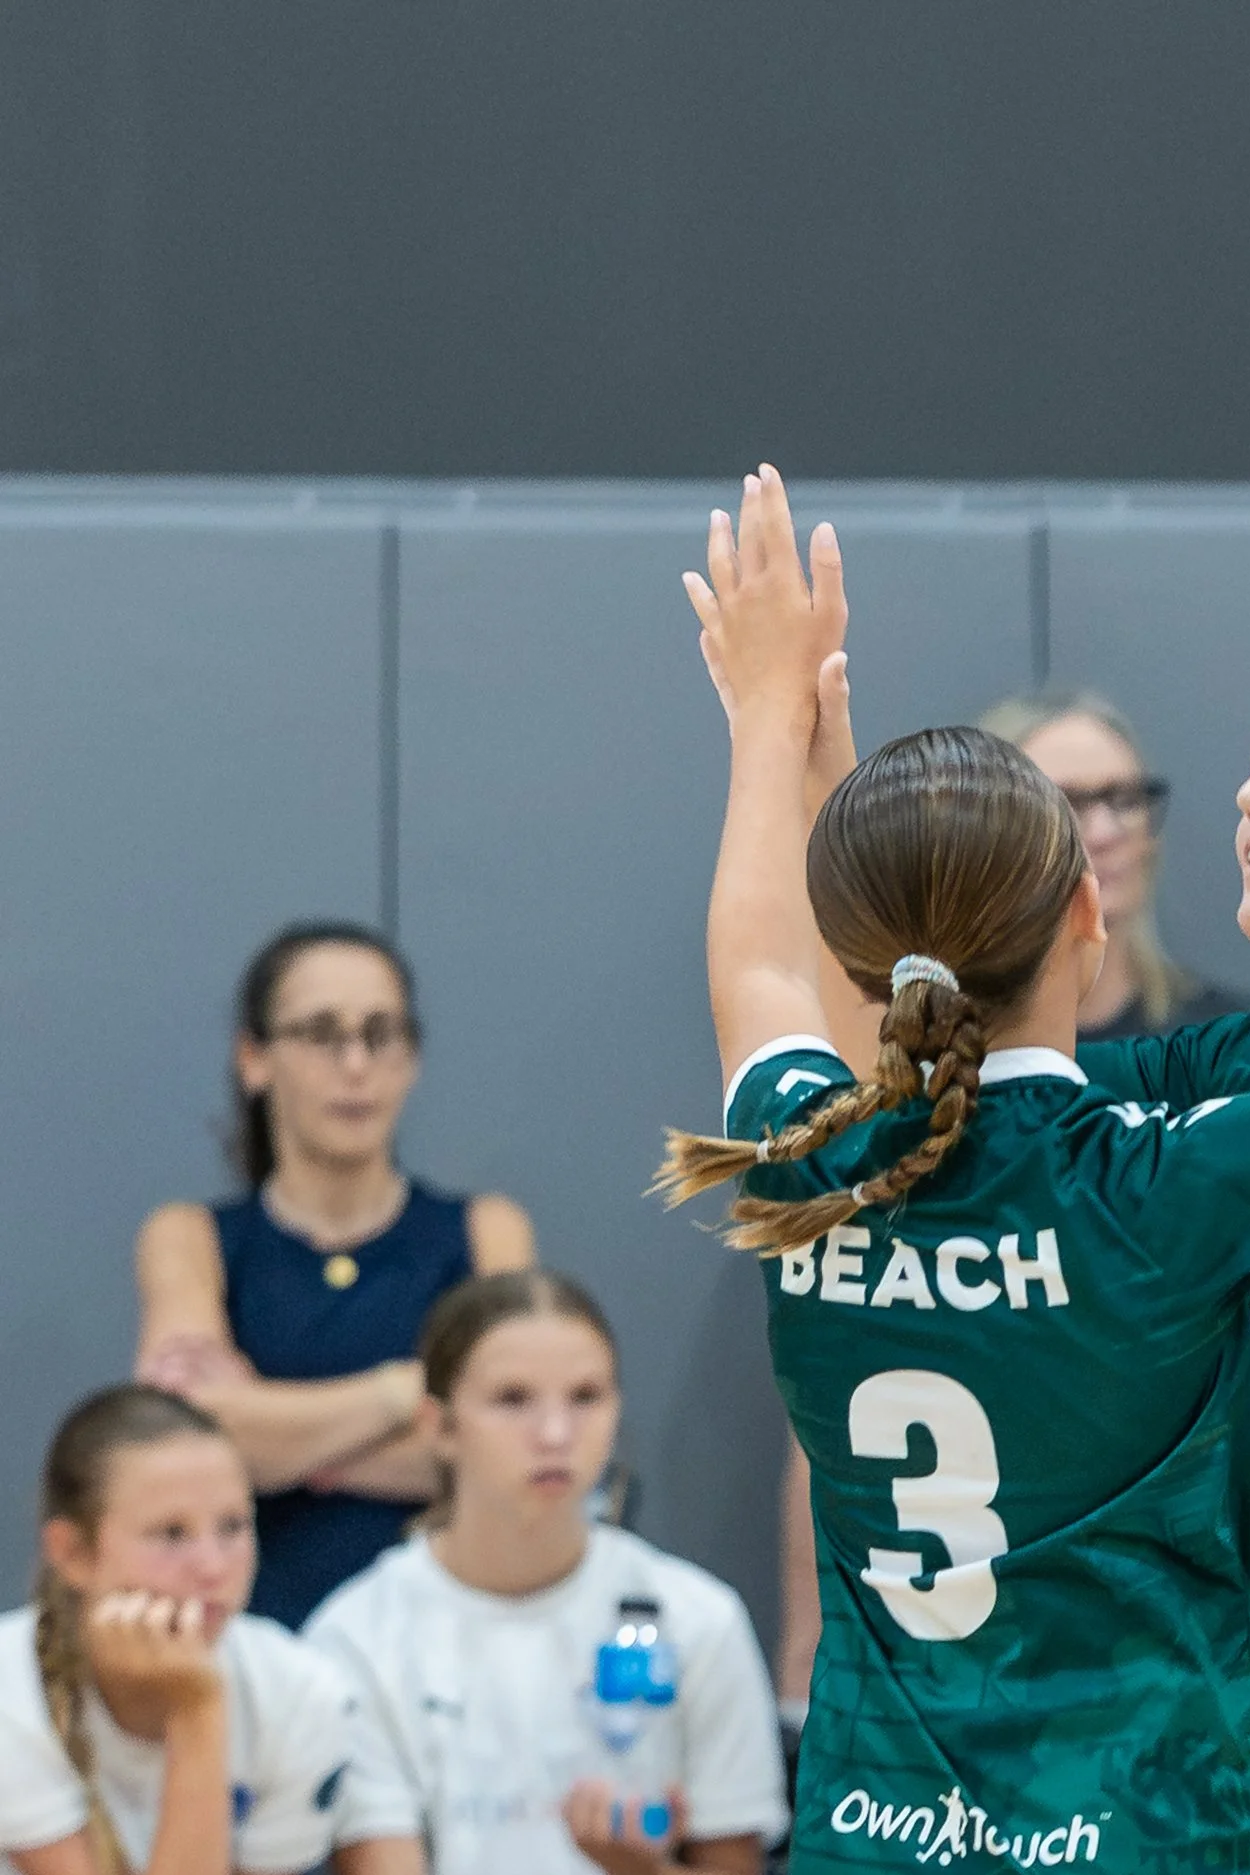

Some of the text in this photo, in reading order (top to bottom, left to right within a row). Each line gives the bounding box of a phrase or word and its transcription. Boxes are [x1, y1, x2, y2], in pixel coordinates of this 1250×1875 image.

[780, 1224, 1070, 1312] BEACH
[848, 1368, 1009, 1642] 3
[831, 1788, 1100, 1868] Own Touch
